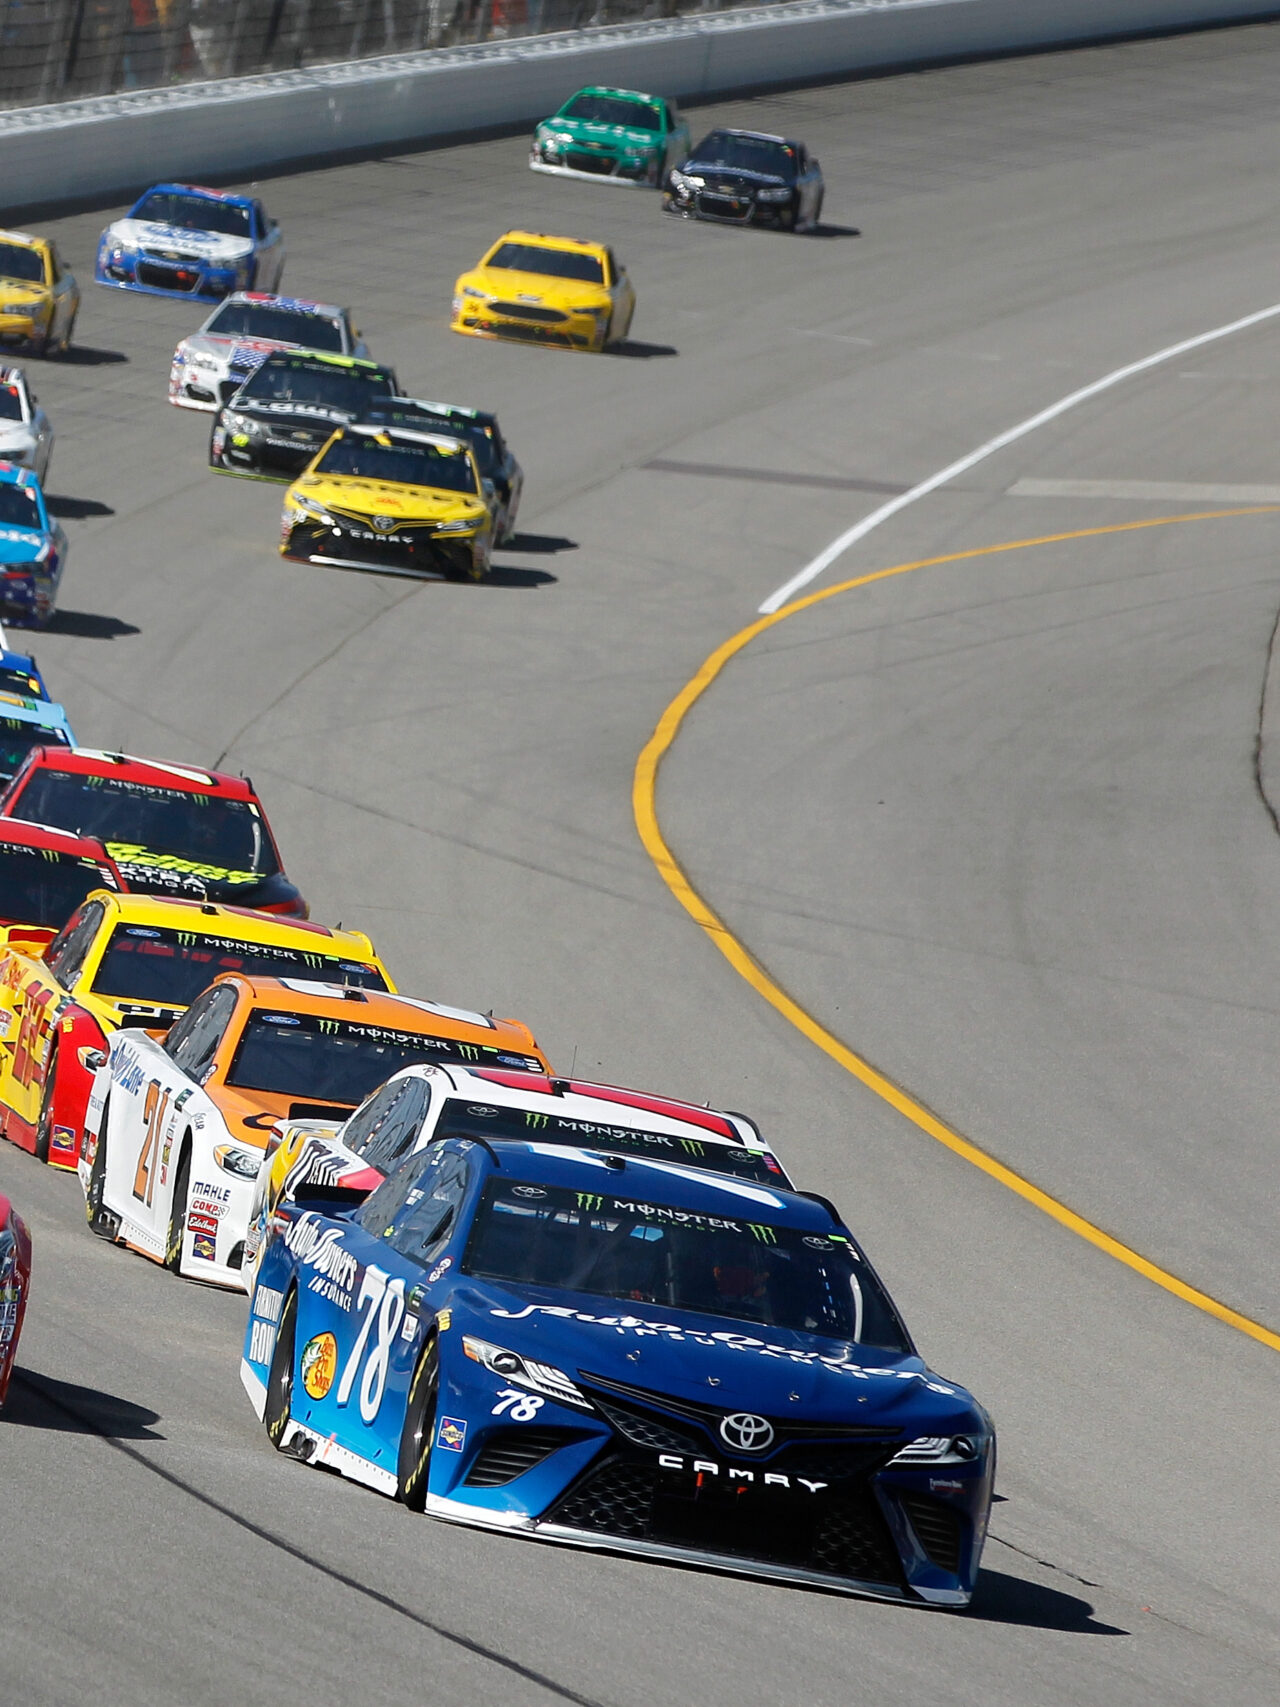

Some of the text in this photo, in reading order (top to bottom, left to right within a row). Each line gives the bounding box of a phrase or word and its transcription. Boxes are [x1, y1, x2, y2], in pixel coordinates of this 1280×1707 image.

[203, 937, 298, 961] MONSTER
[347, 1025, 451, 1051] MONSTER
[558, 1119, 674, 1147] MONSTER
[192, 1181, 231, 1202] MAHLE
[192, 1199, 219, 1214] COMP
[613, 1200, 742, 1233] MONSTER
[336, 1263, 408, 1426] 78
[489, 1303, 956, 1396] Auto-Owners
[491, 1389, 545, 1422] 78
[659, 1454, 829, 1493] CAMRY
